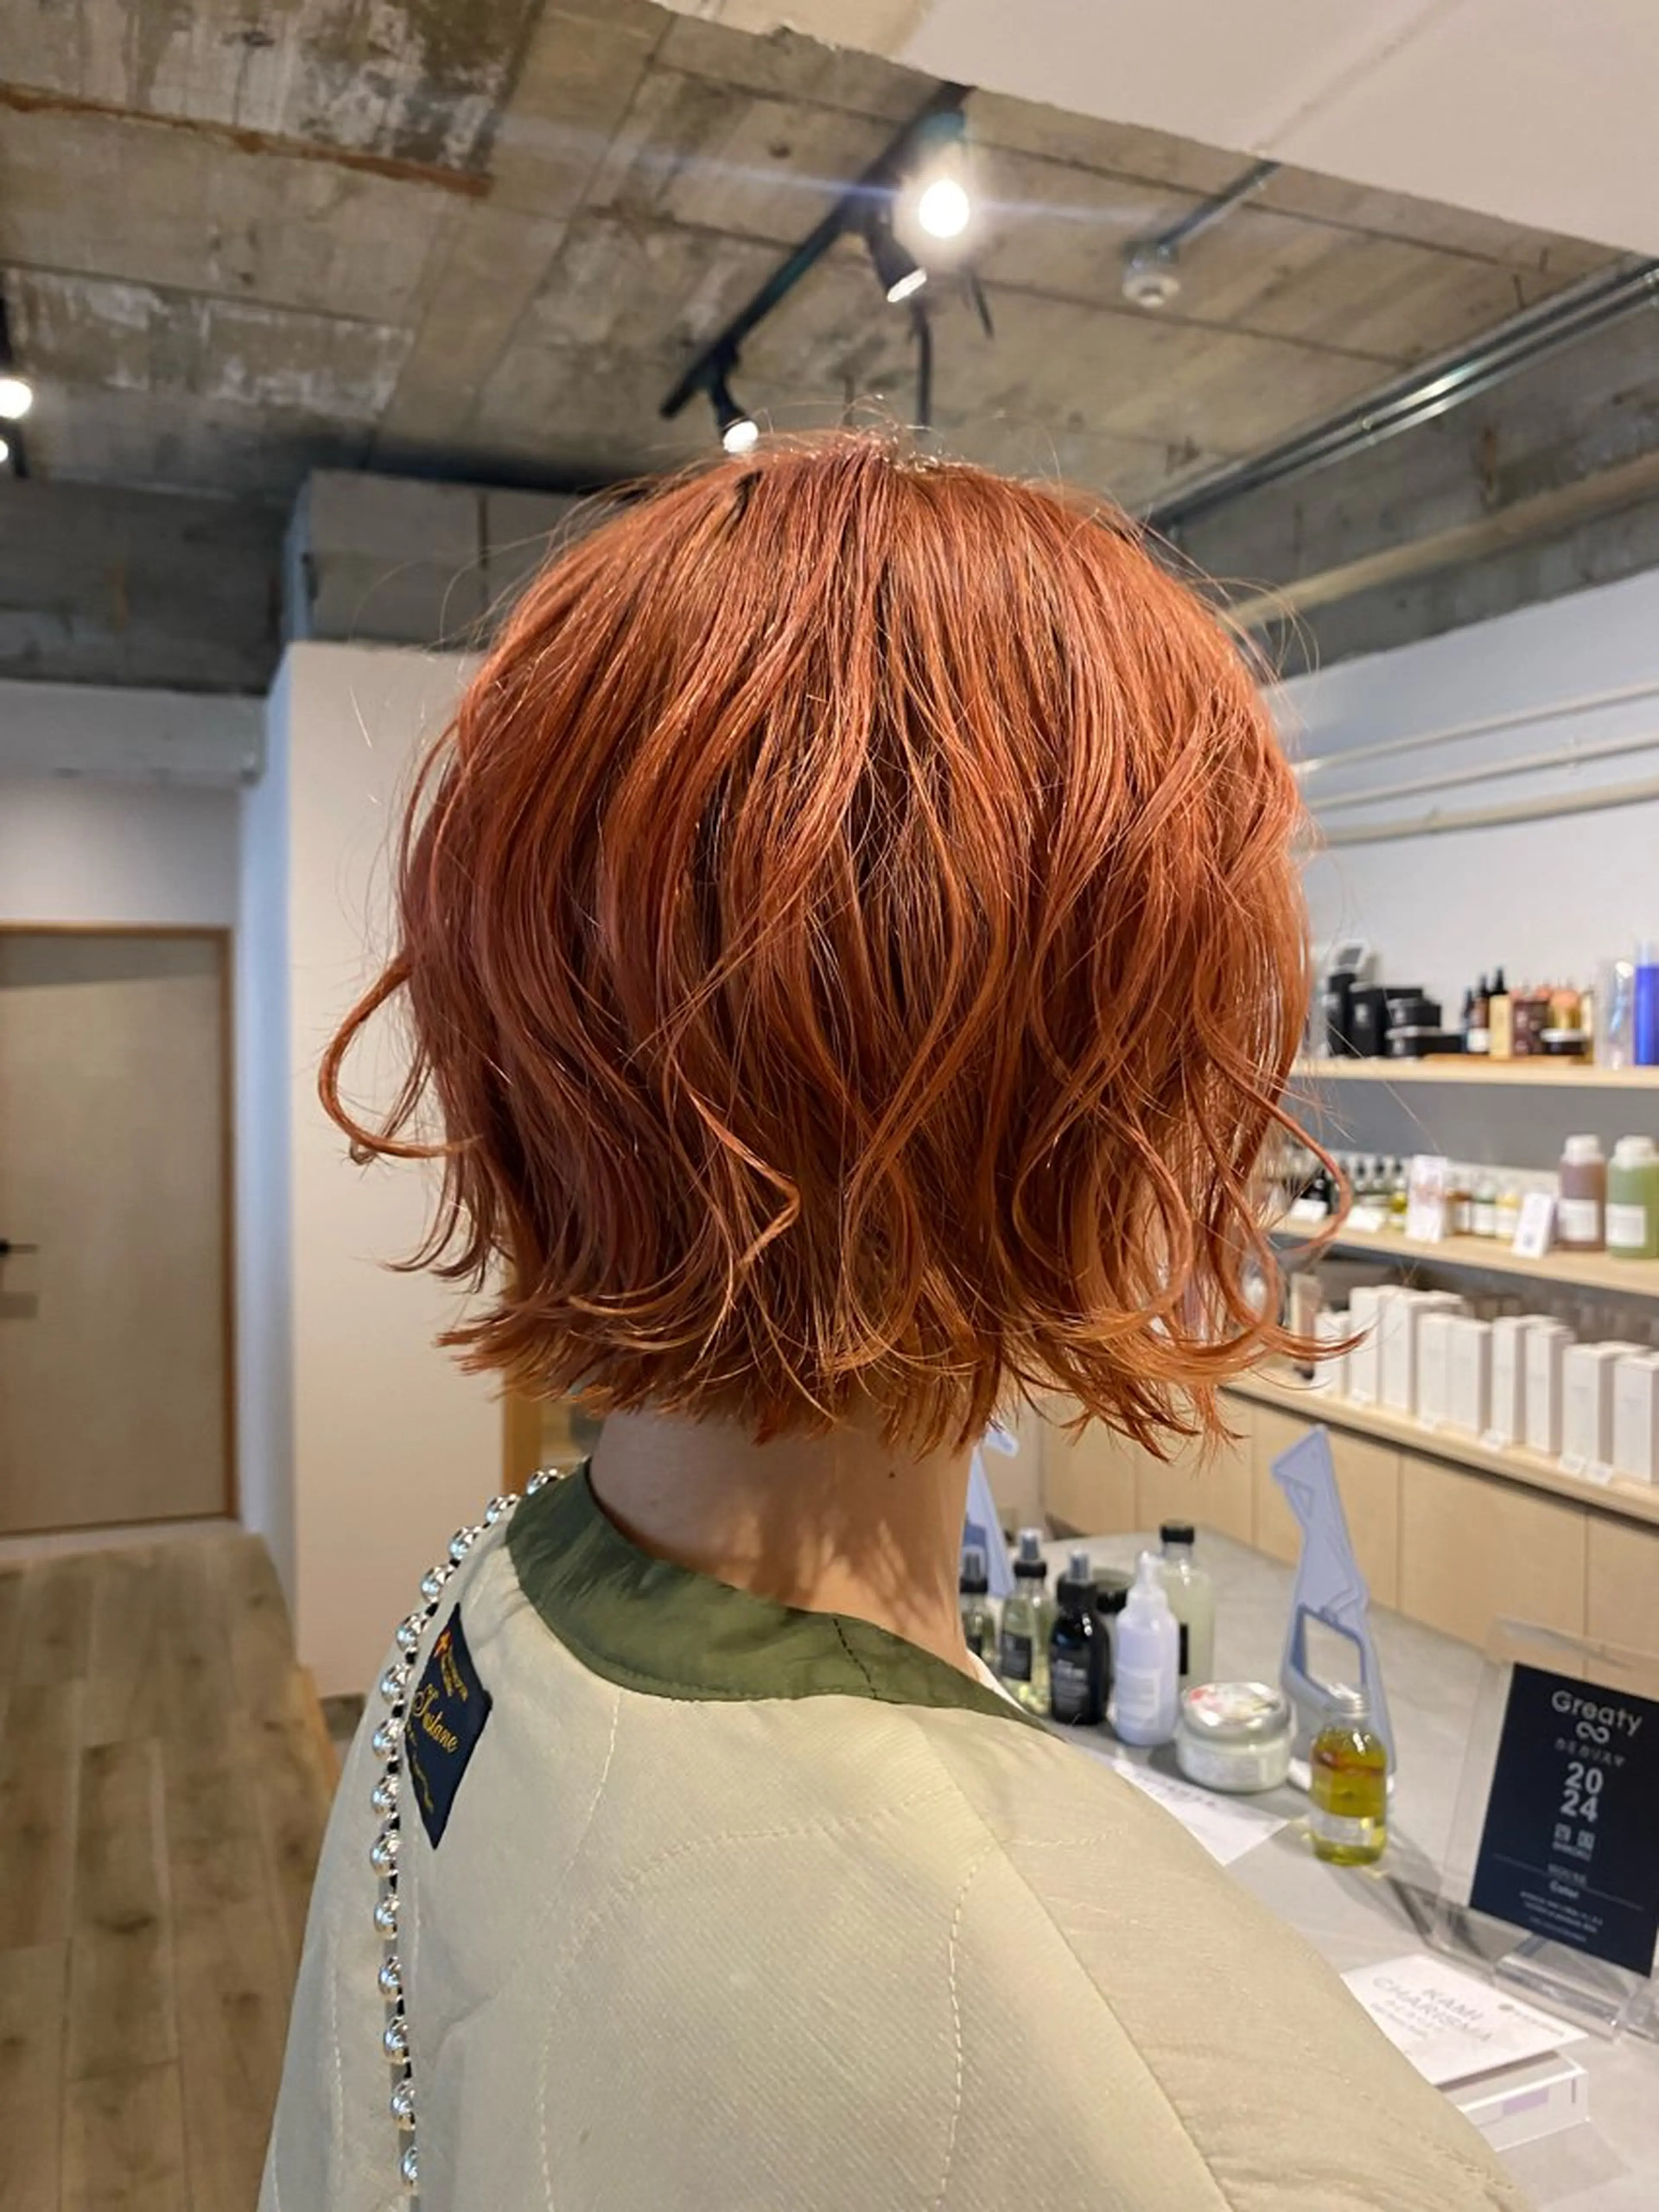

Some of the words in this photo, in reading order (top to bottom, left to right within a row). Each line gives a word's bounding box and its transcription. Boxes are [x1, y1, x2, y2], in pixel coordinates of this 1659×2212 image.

[1551, 1690, 1642, 1737] Greaty
[1564, 1761, 1604, 1796] 20
[1560, 1788, 1598, 1823] 24
